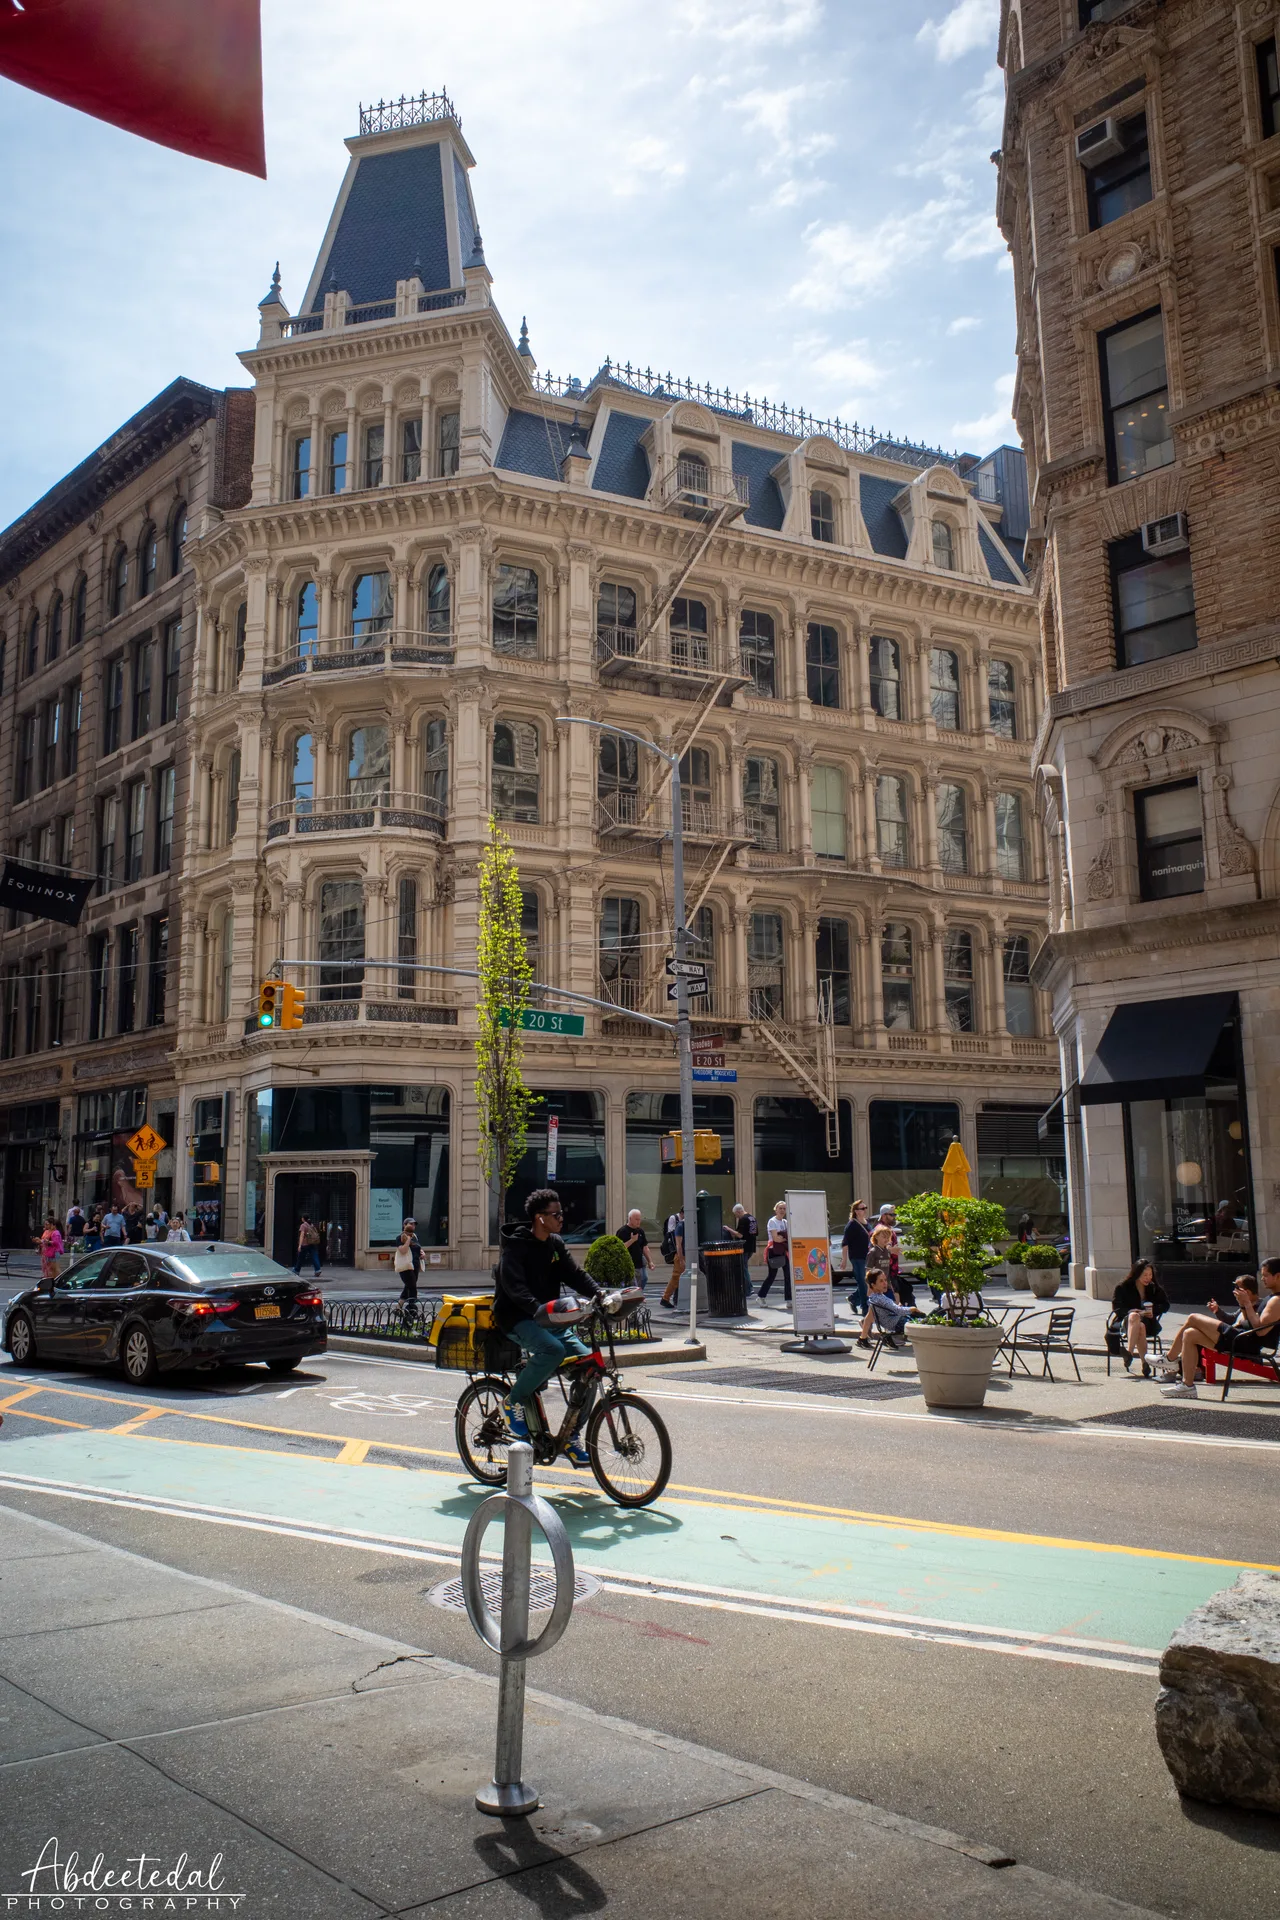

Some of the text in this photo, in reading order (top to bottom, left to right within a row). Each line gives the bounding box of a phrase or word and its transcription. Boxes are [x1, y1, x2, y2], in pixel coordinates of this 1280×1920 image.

[7, 878, 76, 902] EQUINOX
[671, 963, 684, 972] ONE
[690, 983, 703, 992] WAY
[529, 1014, 545, 1028] 20
[551, 1016, 563, 1030] St
[691, 1040, 713, 1050] Broadway
[696, 1056, 722, 1066] E 20 St
[142, 1172, 148, 1180] 5
[1176, 1207, 1190, 1215] The
[1178, 1225, 1196, 1233] Event
